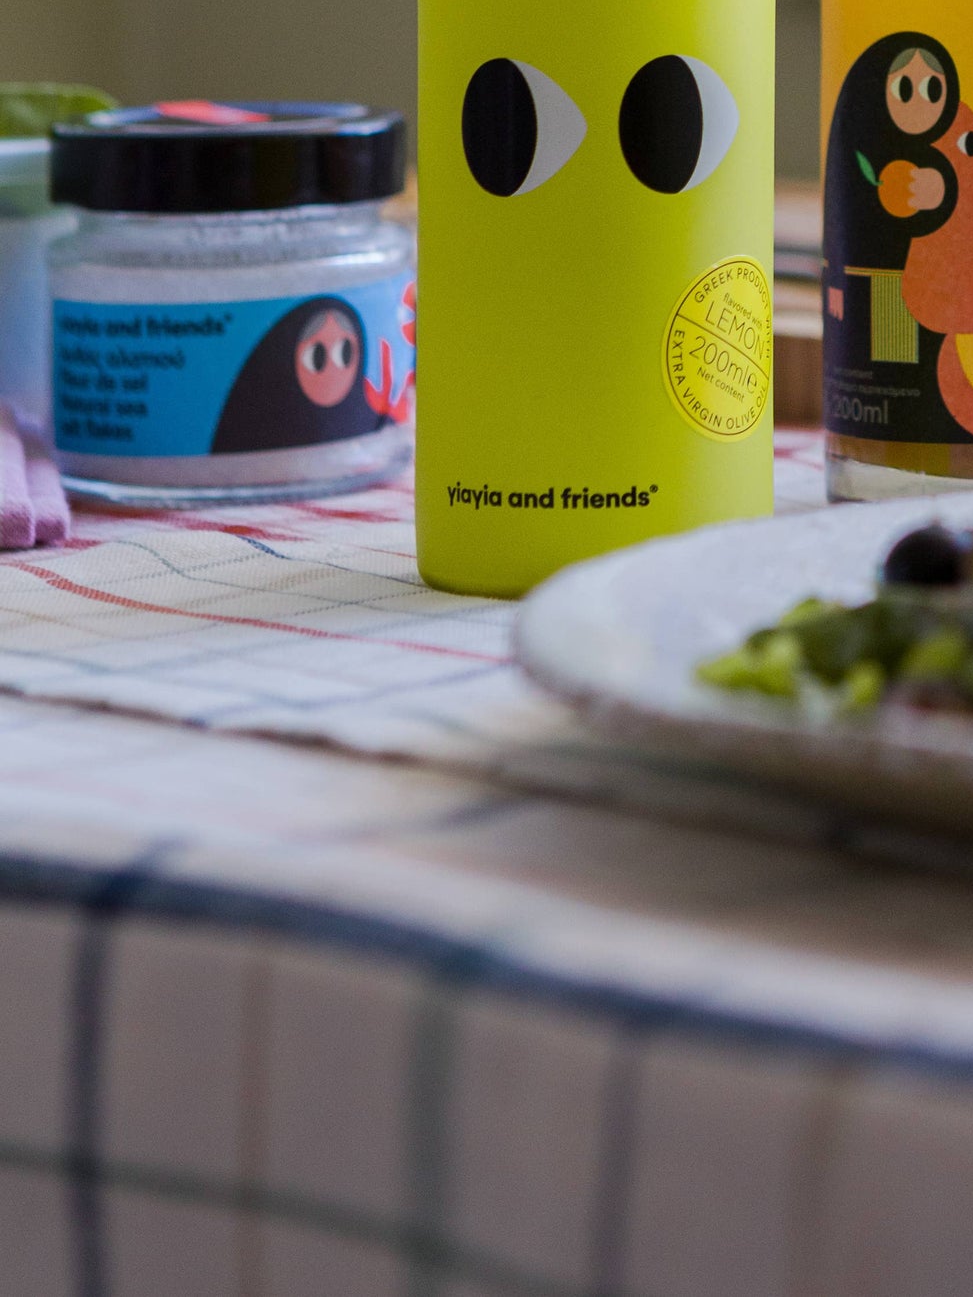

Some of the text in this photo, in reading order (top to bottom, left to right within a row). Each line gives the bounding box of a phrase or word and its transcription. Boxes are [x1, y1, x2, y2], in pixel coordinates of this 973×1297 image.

[694, 267, 768, 309] GREEK PRODUCT
[723, 292, 752, 318] flavored
[705, 301, 765, 359] LEMON
[672, 329, 686, 385] EXTRA
[683, 388, 723, 428] VIRGIN
[726, 406, 755, 430] OLIVE
[697, 367, 745, 403] Net content
[447, 481, 502, 510] yiayia
[508, 487, 554, 509] and
